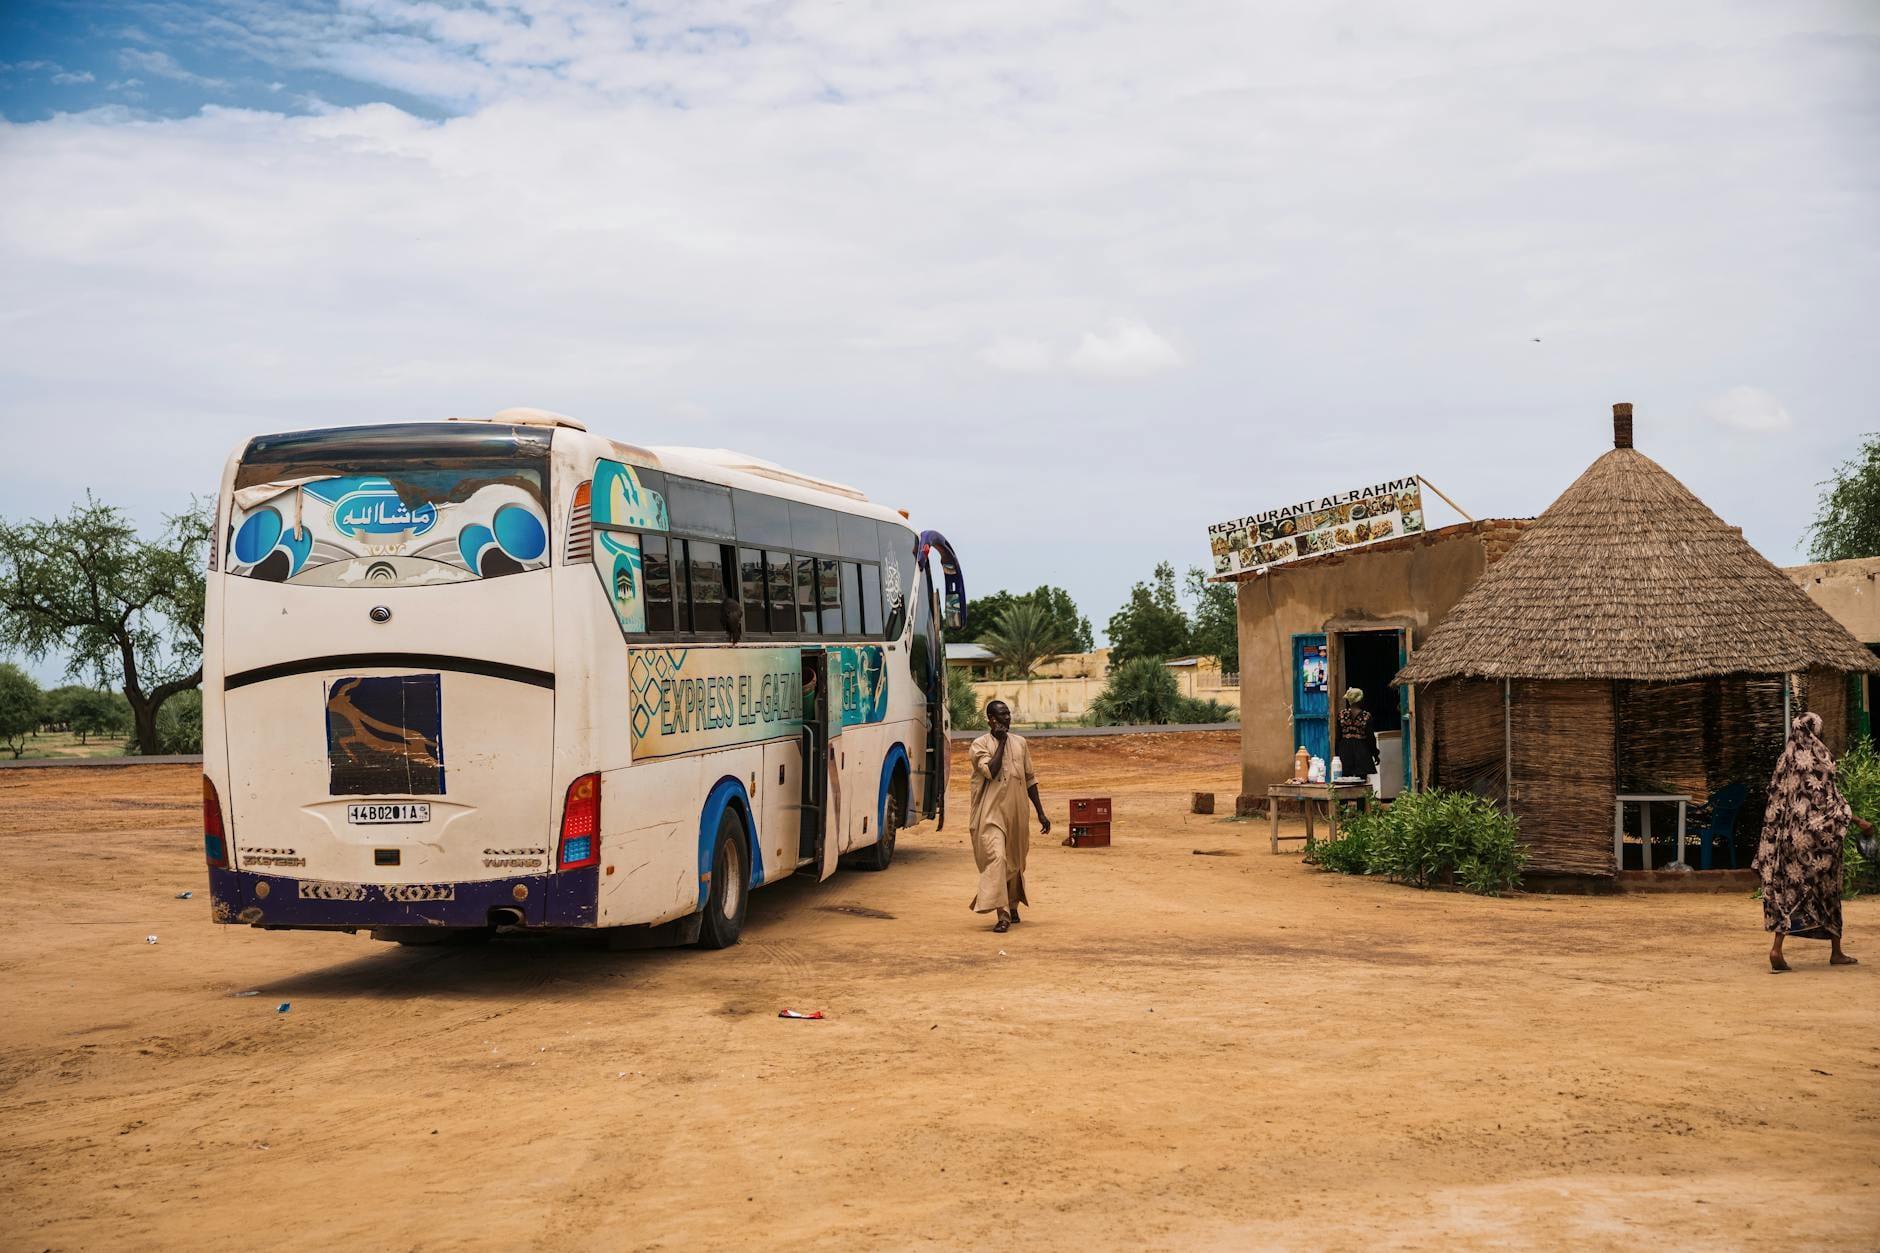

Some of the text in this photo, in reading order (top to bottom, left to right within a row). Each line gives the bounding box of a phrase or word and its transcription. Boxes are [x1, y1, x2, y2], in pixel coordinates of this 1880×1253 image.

[1208, 476, 1417, 535] RESTAURANT AL-RAHMA
[661, 675, 734, 735] EXPRESS
[482, 859, 542, 868] YUTONG
